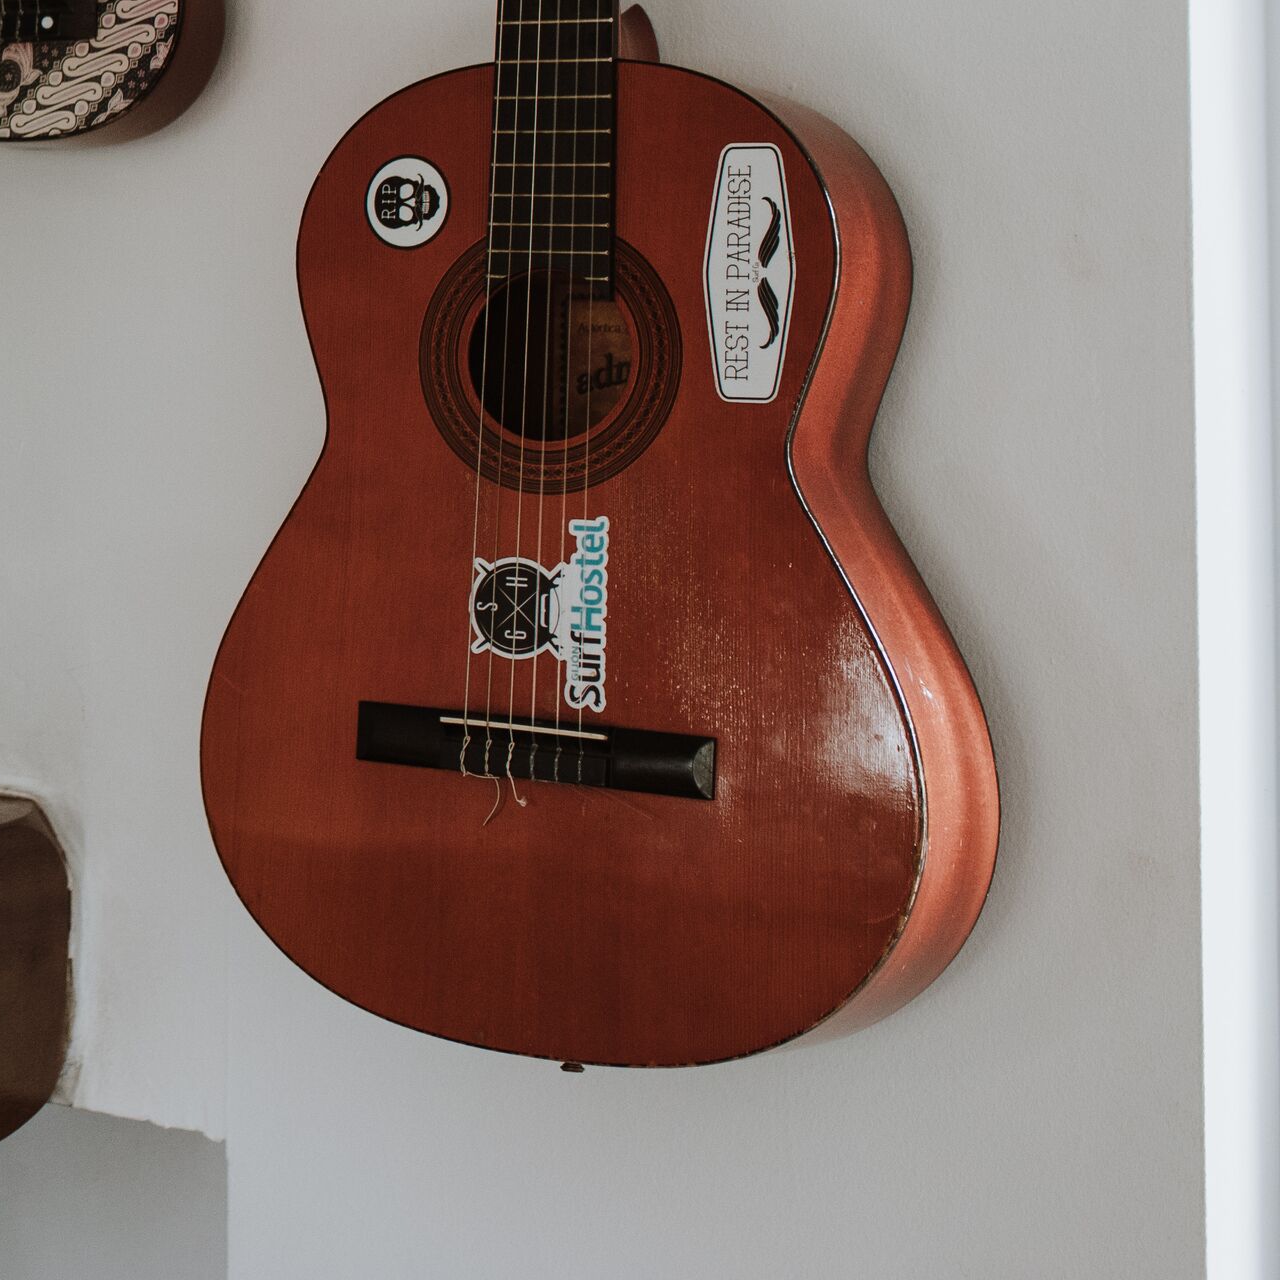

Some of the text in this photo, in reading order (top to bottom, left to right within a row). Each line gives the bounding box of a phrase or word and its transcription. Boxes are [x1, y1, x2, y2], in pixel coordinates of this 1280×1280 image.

[381, 184, 397, 220] RIP
[724, 164, 752, 381] REST IN PARADISE
